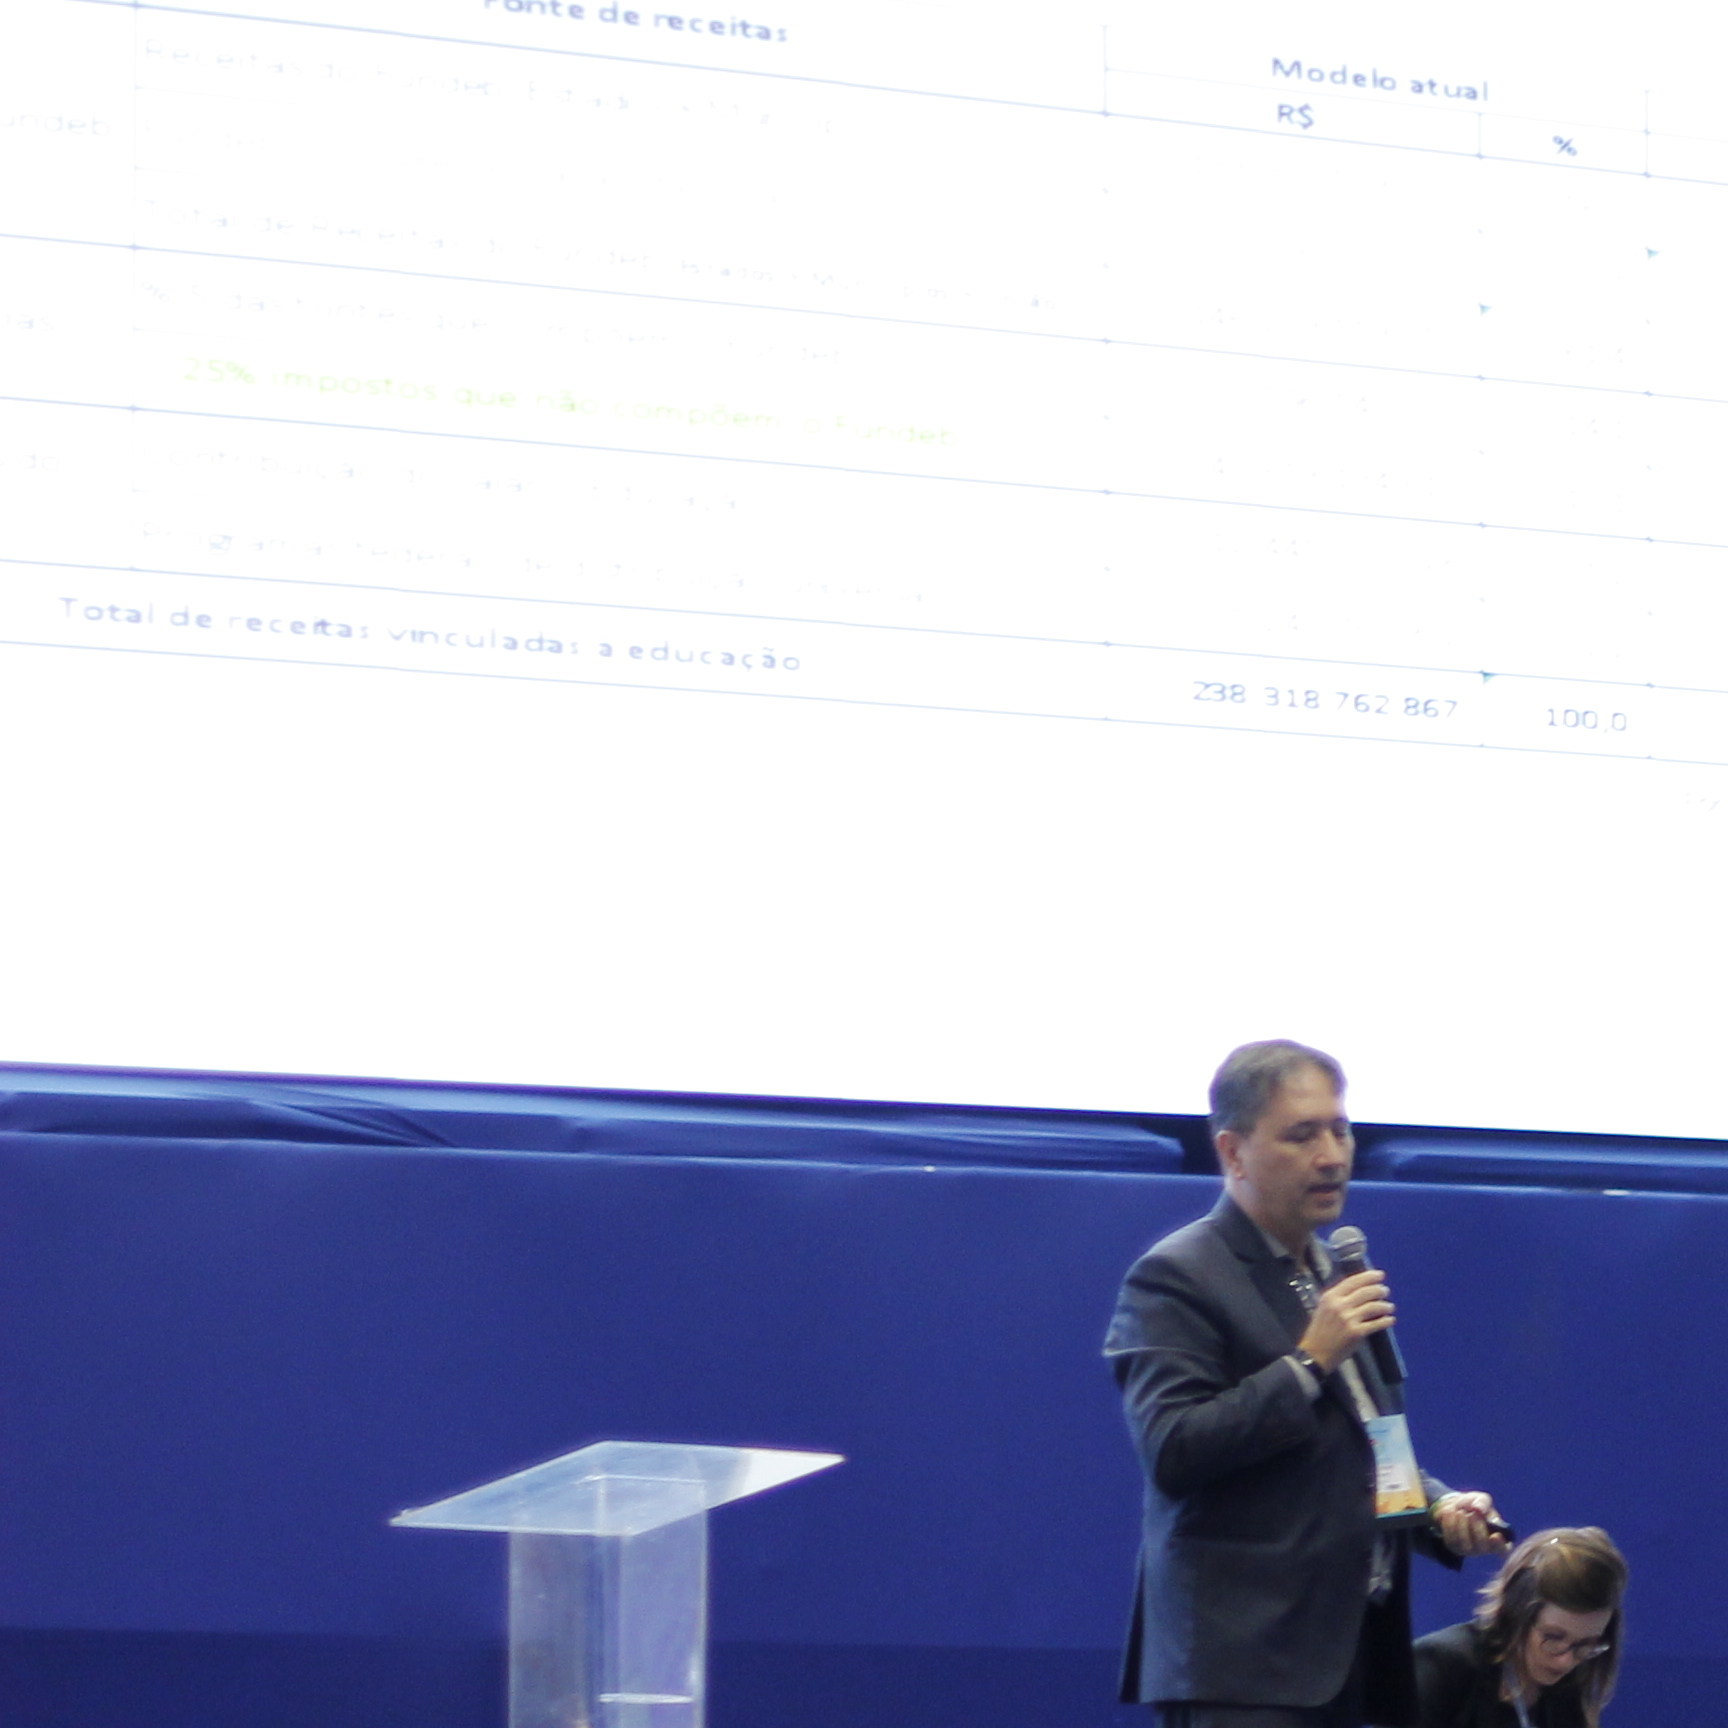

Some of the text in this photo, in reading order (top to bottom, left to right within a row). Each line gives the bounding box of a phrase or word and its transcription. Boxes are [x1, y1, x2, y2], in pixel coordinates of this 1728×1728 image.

[596, 0, 642, 28] de
[652, 12, 789, 44] receitas
[1270, 55, 1490, 103] Modelo atual
[1275, 101, 1316, 132] R$
[1551, 134, 1579, 158] %
[270, 360, 441, 403] impostos
[58, 595, 155, 626] Total
[168, 606, 214, 631] de
[228, 615, 370, 641] receitas
[388, 627, 580, 656] vinculadas
[626, 641, 802, 673] educação
[1192, 679, 1248, 705] 238
[1263, 684, 1322, 711] 318
[1334, 689, 1391, 716] 762
[1402, 695, 1459, 720] 867
